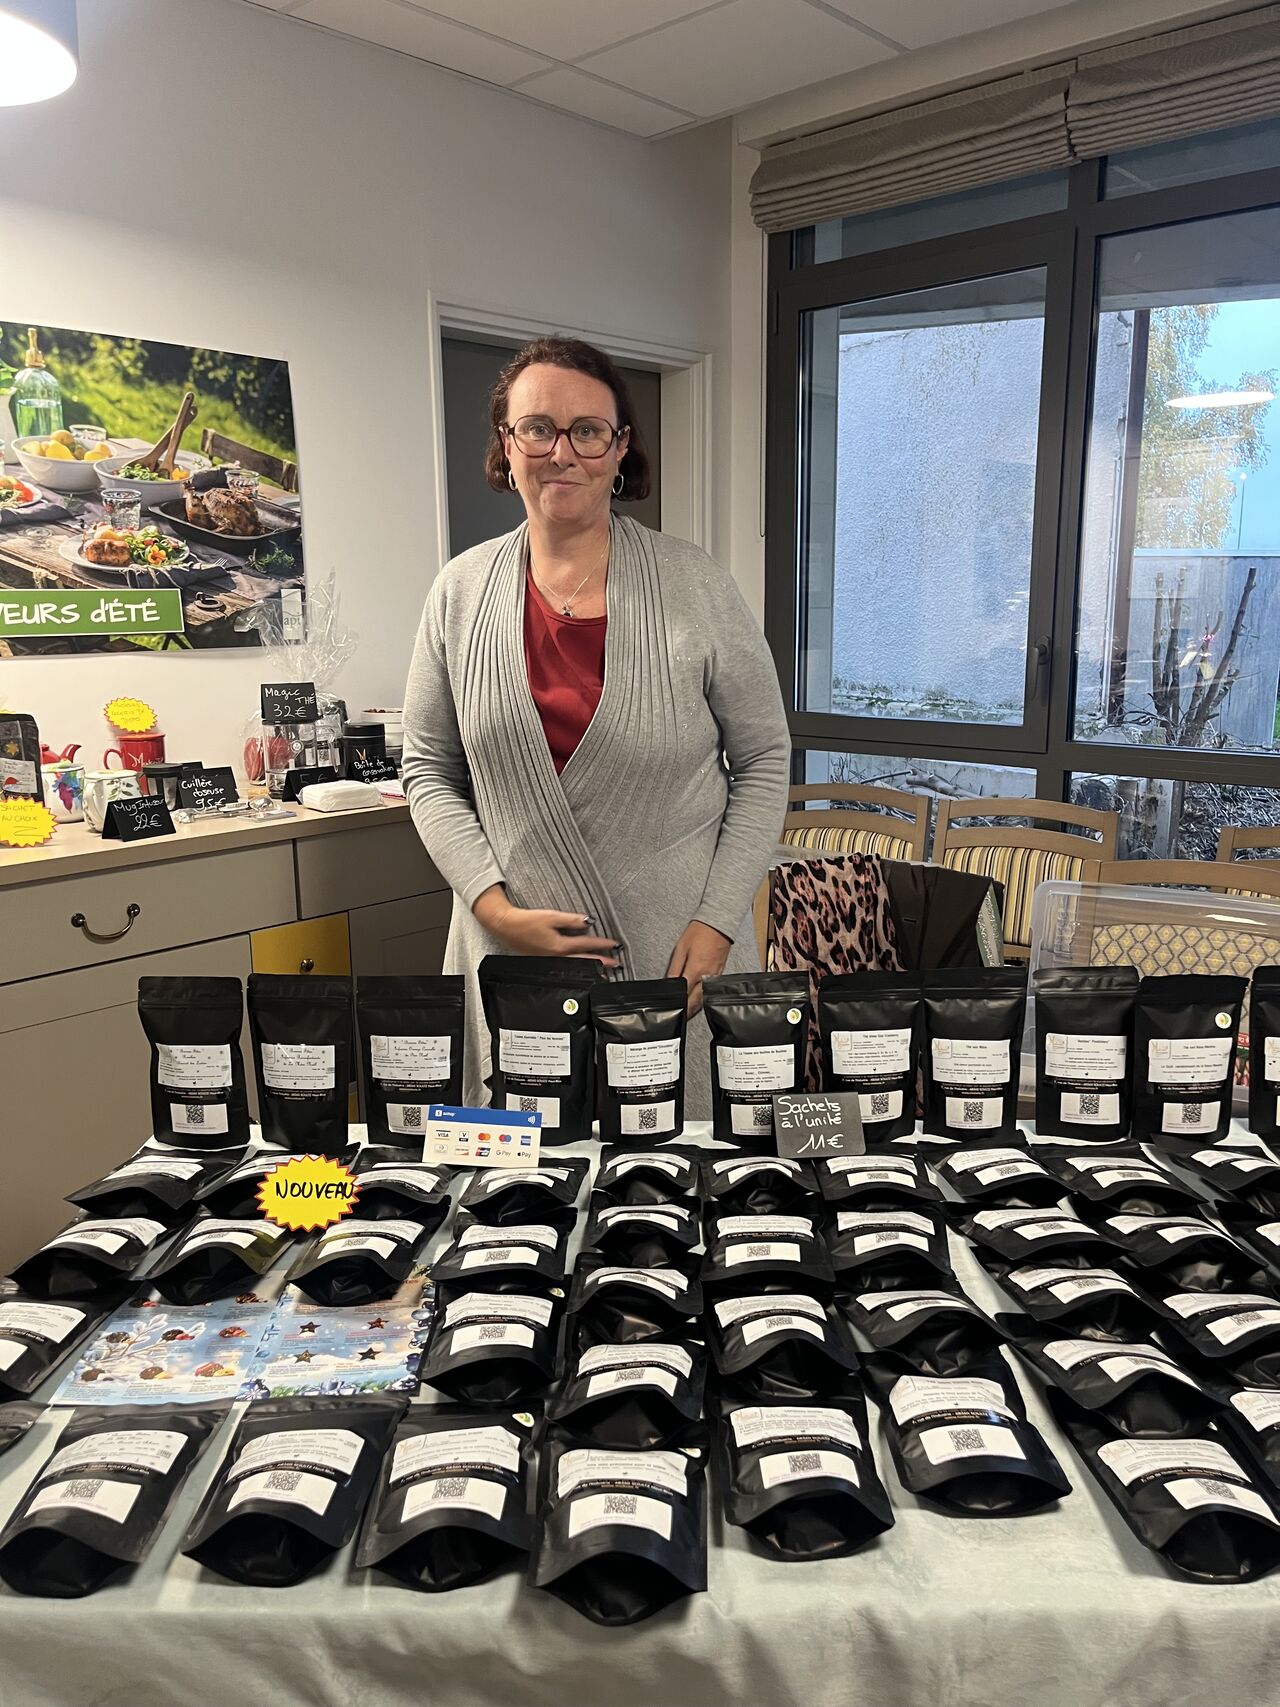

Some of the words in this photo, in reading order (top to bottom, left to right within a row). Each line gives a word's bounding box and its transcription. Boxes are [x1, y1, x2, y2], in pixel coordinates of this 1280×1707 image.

[0, 603, 81, 625] EURS
[90, 597, 161, 623] d'ÉTÉ
[264, 686, 301, 701] Magic
[294, 692, 316, 705] THÉ
[273, 703, 308, 718] 32€
[112, 801, 138, 817] Mug
[133, 812, 163, 832] 22€
[777, 1096, 842, 1116] Sachets
[794, 1112, 842, 1128] l'unité
[797, 1133, 844, 1153] 11€
[275, 1178, 354, 1200] NOUVEAU
